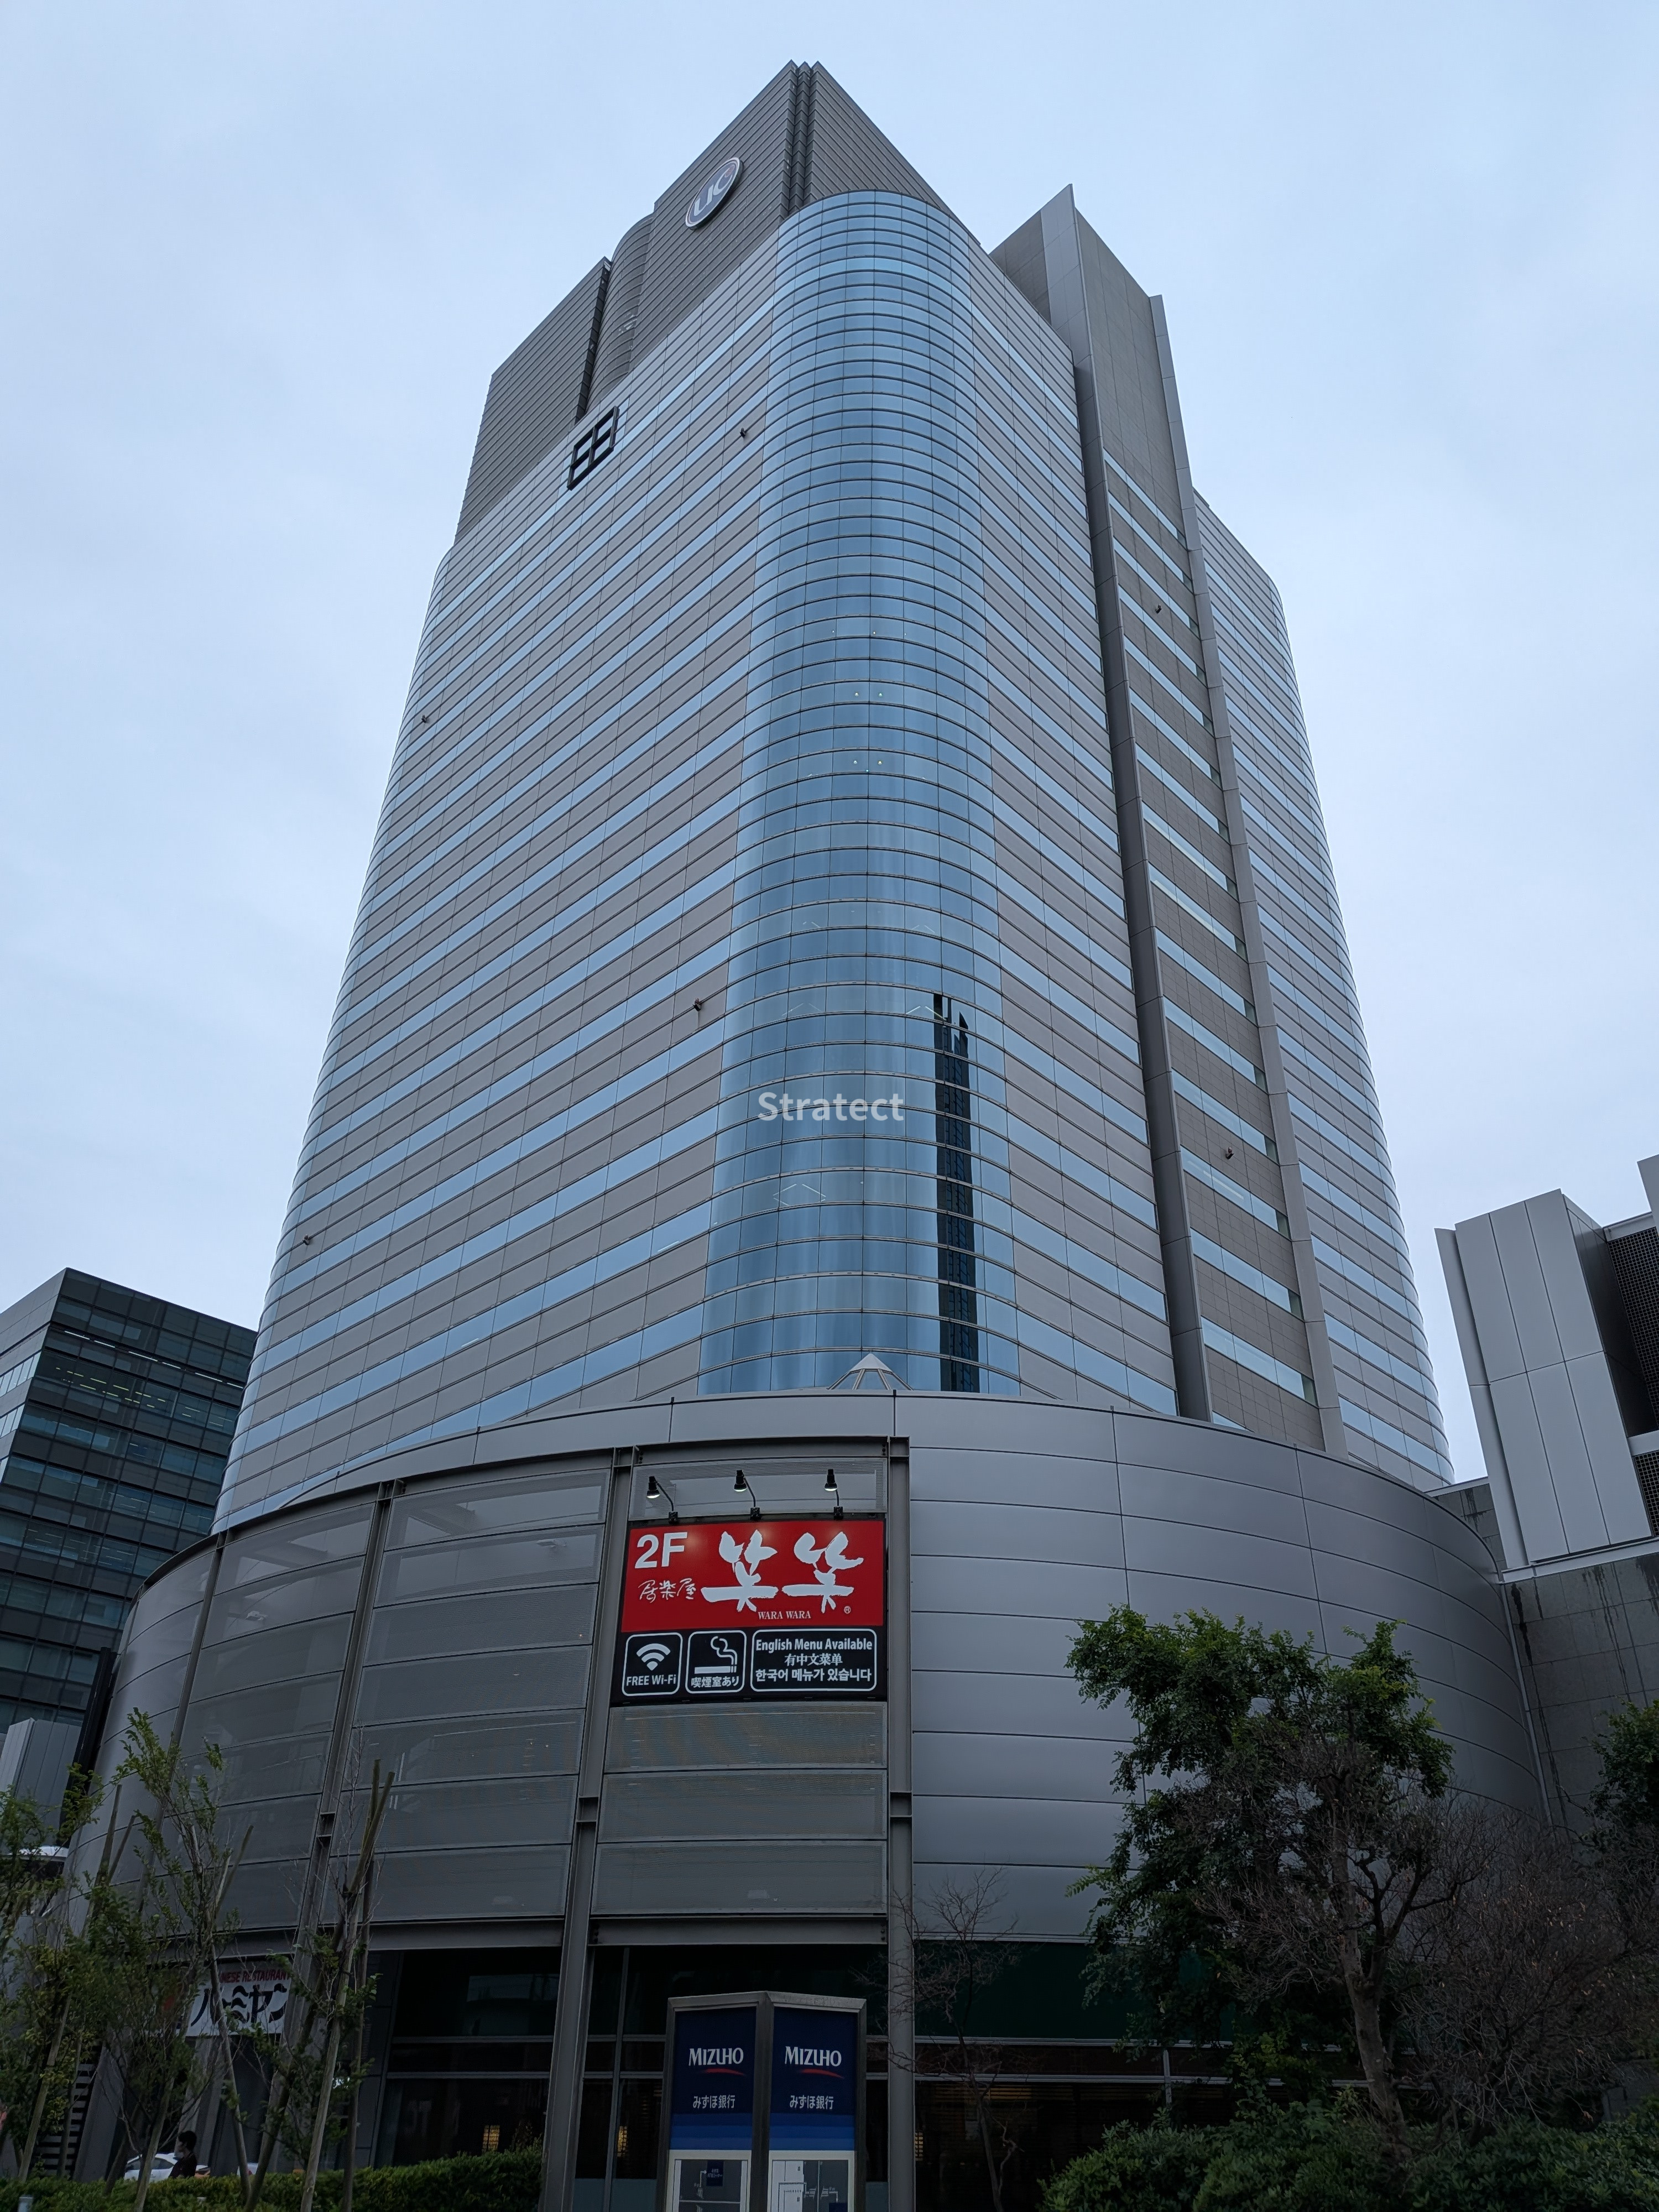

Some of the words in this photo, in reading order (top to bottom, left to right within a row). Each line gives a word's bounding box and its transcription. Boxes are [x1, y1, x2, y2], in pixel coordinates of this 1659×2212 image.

[635, 1532, 687, 1568] 2F
[701, 1530, 864, 1613] 笑笑
[758, 1611, 783, 1620] WARA
[786, 1610, 811, 1619] WARA
[756, 1639, 792, 1653] English
[794, 1639, 823, 1650] Menu
[825, 1638, 873, 1650] Available
[784, 1653, 843, 1667] 有中文菜单
[626, 1676, 649, 1686] FREE
[652, 1674, 676, 1684] Wi-Fi
[691, 1676, 739, 1688] 喫煙室あり
[755, 1668, 789, 1682] 한국어
[791, 1668, 825, 1682] 메뉴가
[827, 1668, 872, 1682] 있습니다
[688, 2047, 744, 2066] MIZUHO
[784, 2046, 842, 2067] MIZUHO
[692, 2095, 735, 2109] みずほ銀行
[789, 2095, 834, 2110] みずほ銀行
